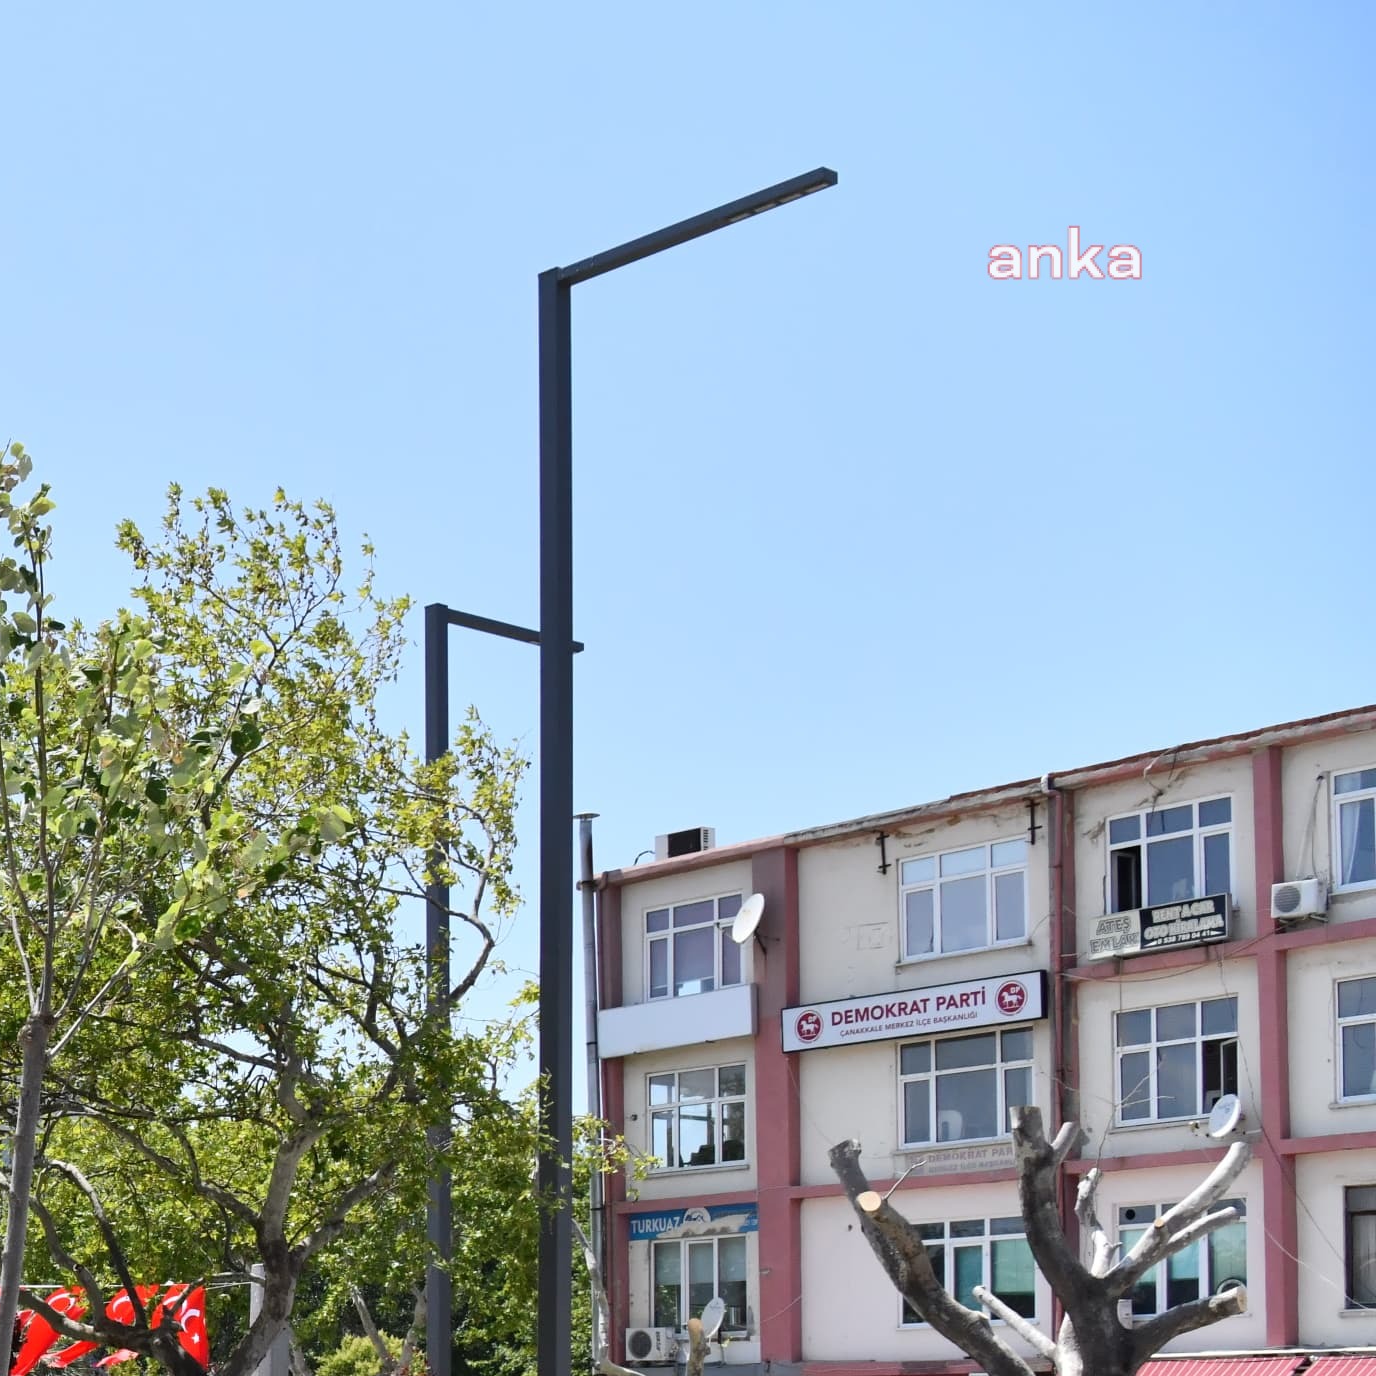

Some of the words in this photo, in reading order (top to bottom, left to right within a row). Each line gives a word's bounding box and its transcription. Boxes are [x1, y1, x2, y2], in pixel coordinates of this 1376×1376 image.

[831, 999, 930, 1026] DEMOKRAT
[936, 986, 986, 1011] PARTİ
[840, 1023, 883, 1038] ÇANAKKALE
[884, 1020, 914, 1031] MERKEZ
[631, 1216, 681, 1234] TURKUAZ
